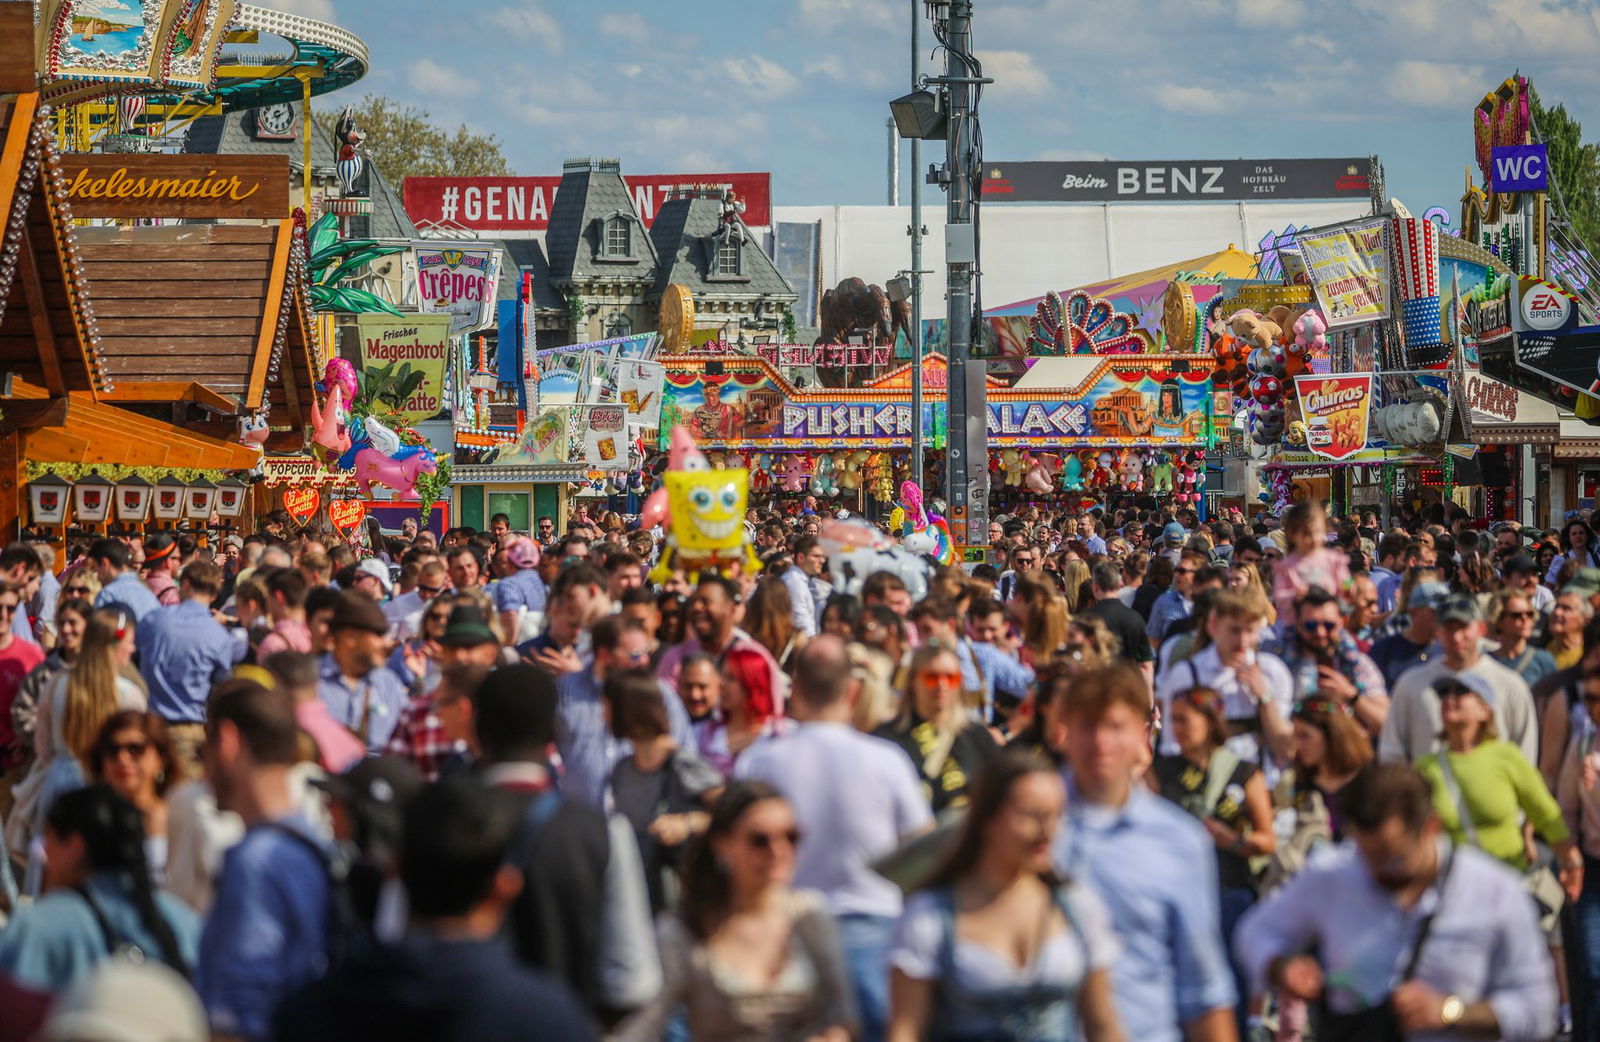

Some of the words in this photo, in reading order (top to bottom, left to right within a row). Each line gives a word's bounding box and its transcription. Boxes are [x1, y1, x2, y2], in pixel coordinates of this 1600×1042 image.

[1062, 174, 1108, 190] Beim
[1117, 167, 1224, 194] BENZ
[1243, 175, 1286, 184] HOFBRÄU
[1496, 156, 1541, 181] WC
[58, 168, 260, 200] ckelesmaier
[1361, 231, 1383, 252] Wurf
[419, 268, 486, 304] Crêpes
[1530, 310, 1562, 319] SPORTS
[1531, 294, 1562, 310] EA
[384, 328, 418, 340] Frisches
[366, 338, 444, 363] Magenbrot
[403, 392, 436, 412] atte
[1306, 385, 1364, 412] Churros
[592, 410, 622, 422] Bier
[784, 404, 912, 436] PUSHER
[987, 403, 1086, 434] ALACE
